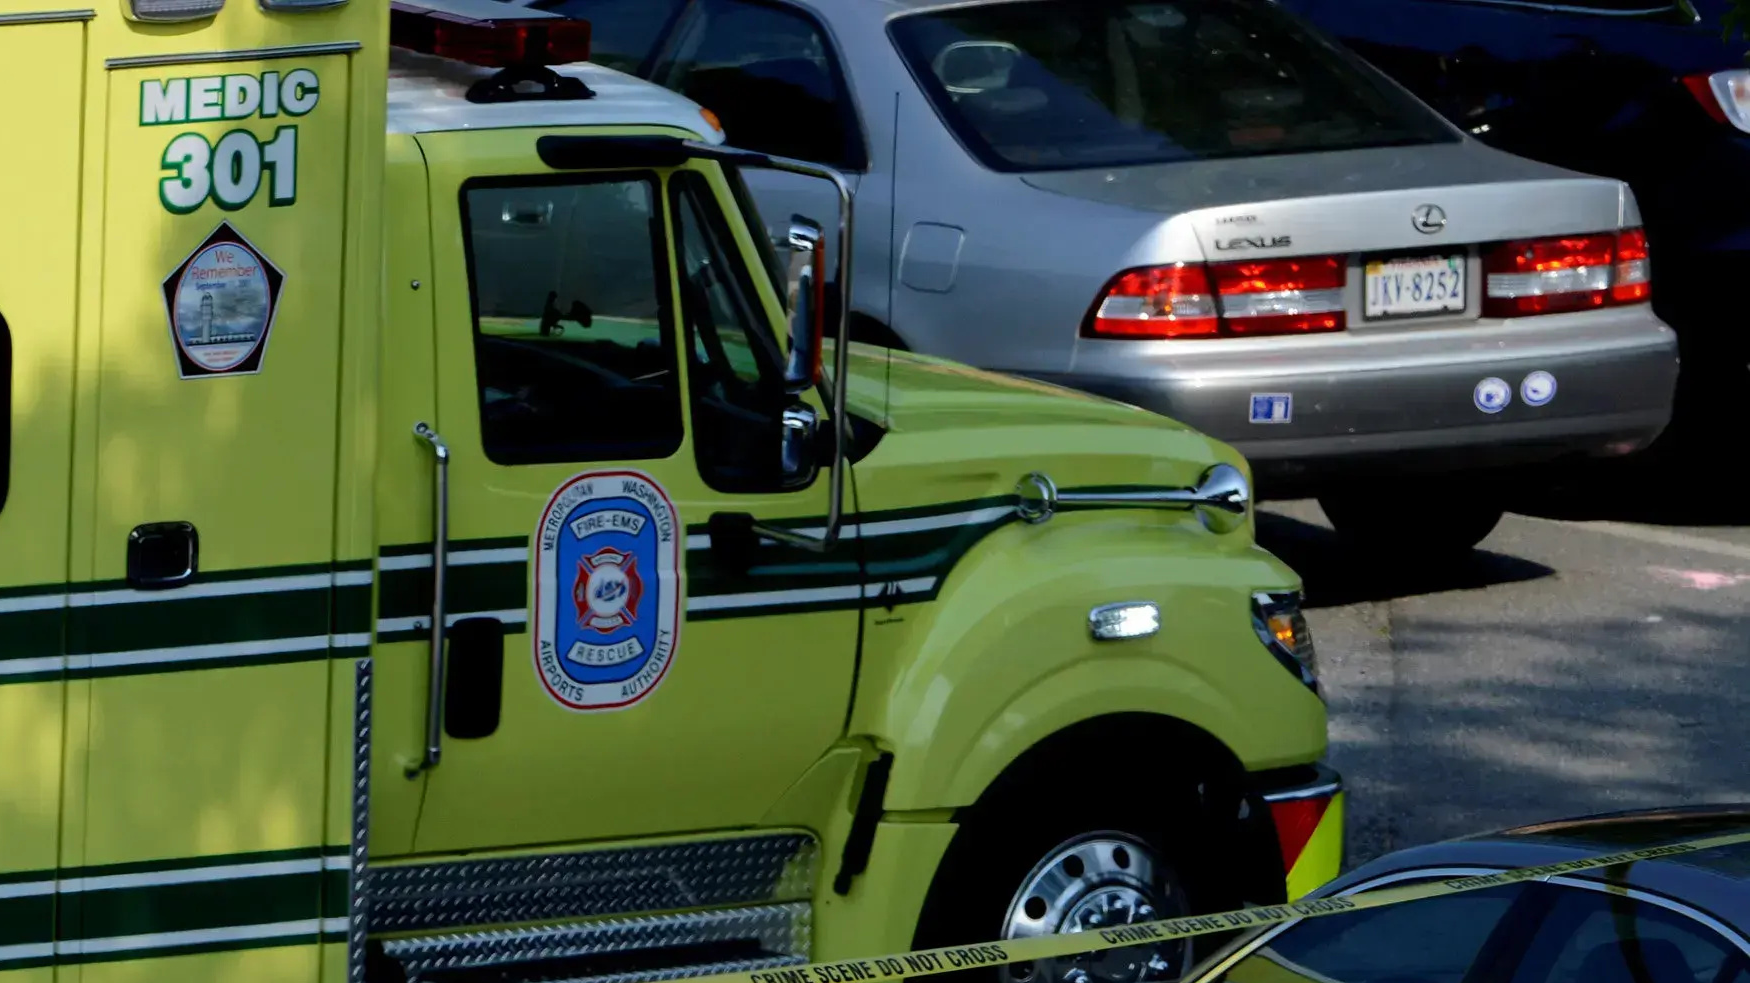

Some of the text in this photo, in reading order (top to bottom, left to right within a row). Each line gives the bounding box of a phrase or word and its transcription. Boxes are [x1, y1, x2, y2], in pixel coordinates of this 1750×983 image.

[139, 68, 320, 127] MEDIC
[159, 124, 298, 215] 301
[1215, 234, 1292, 251] LEXUS
[215, 250, 234, 263] We
[191, 264, 258, 280] Remember
[576, 514, 640, 535] FIRE-EMS
[540, 629, 671, 701] AIRPORTS AUTHORITY
[575, 642, 635, 662] RESCUE
[1098, 898, 1356, 945] CRIME SCENE DO NOT CROSS
[875, 957, 904, 977] DO
[903, 950, 945, 973] NOT
[944, 944, 1009, 968] CROSS
